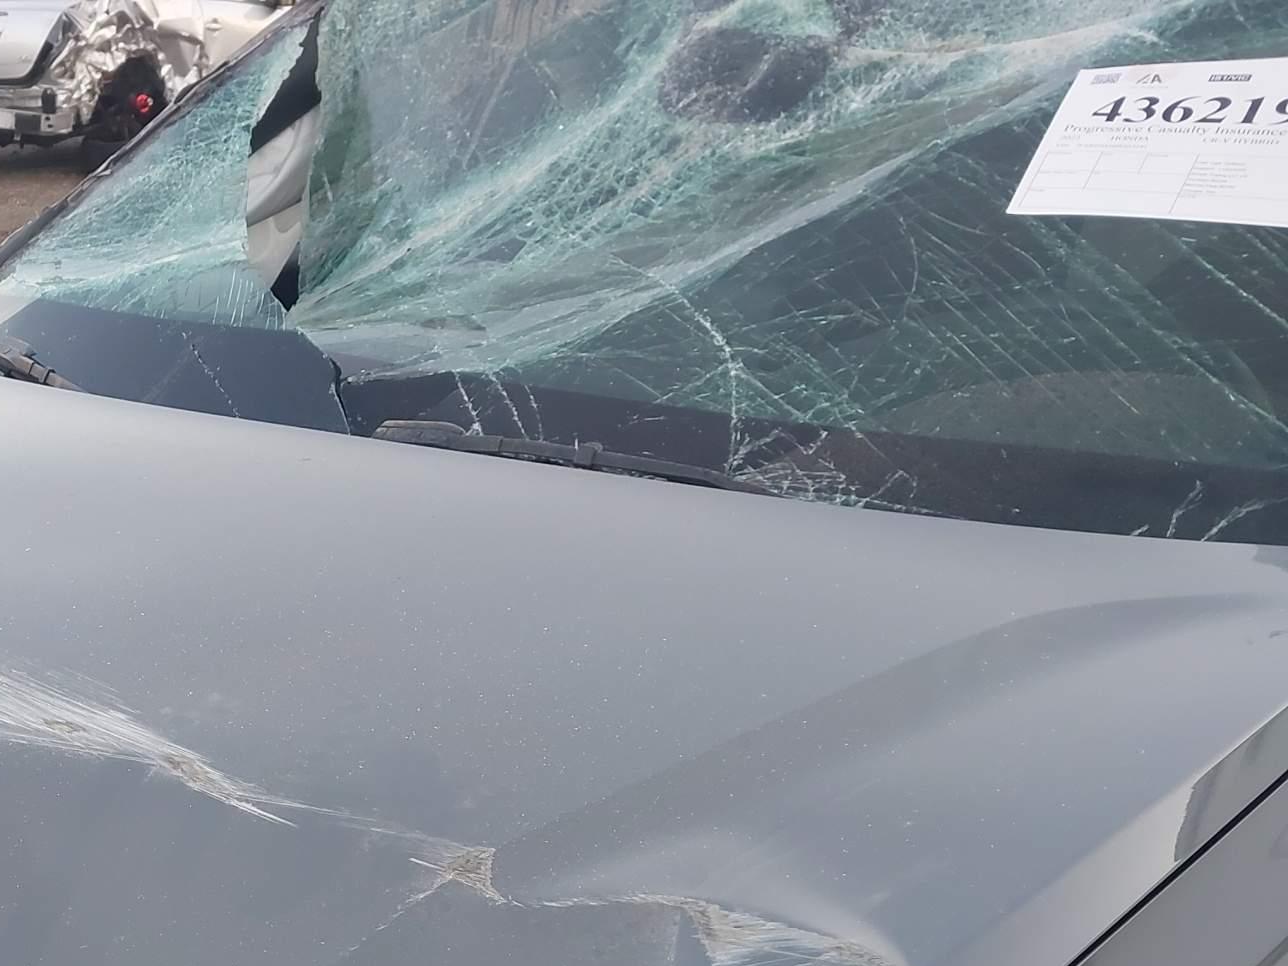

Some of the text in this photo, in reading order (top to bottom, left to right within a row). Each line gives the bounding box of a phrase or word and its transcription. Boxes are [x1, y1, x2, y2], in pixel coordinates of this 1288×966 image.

[1064, 124, 1288, 137] Progressive Casualty Insurance
